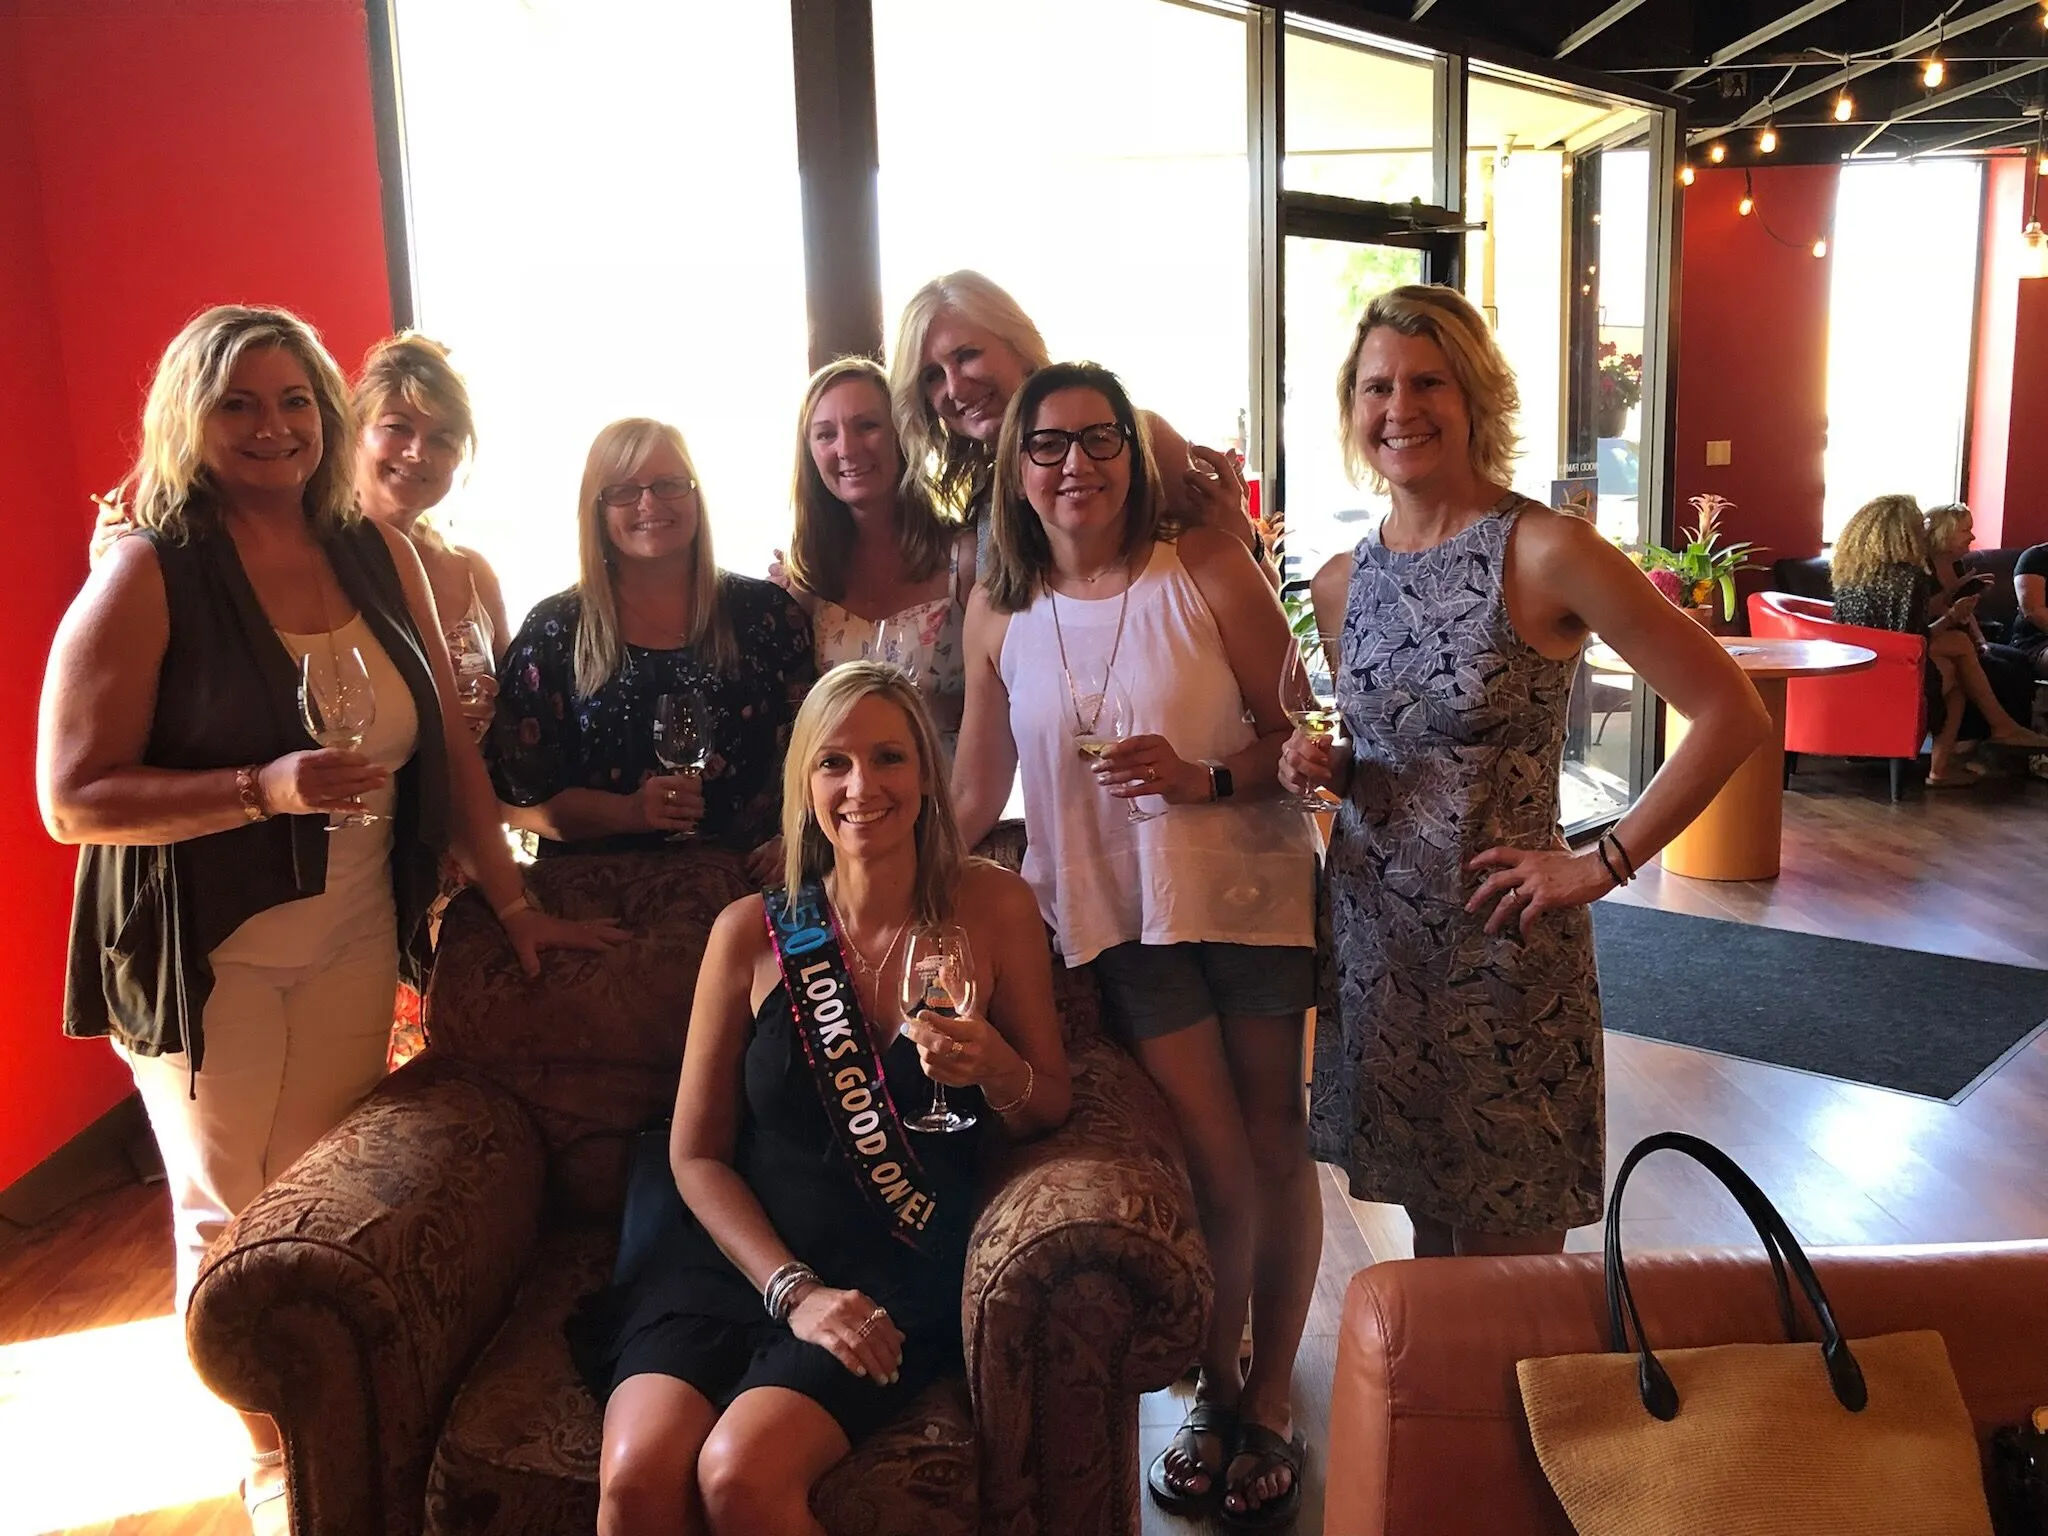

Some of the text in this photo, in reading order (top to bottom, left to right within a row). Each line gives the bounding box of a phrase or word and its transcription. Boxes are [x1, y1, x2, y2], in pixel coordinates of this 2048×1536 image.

[776, 903, 936, 1231] 50 LOOKS GOOD ONE!
